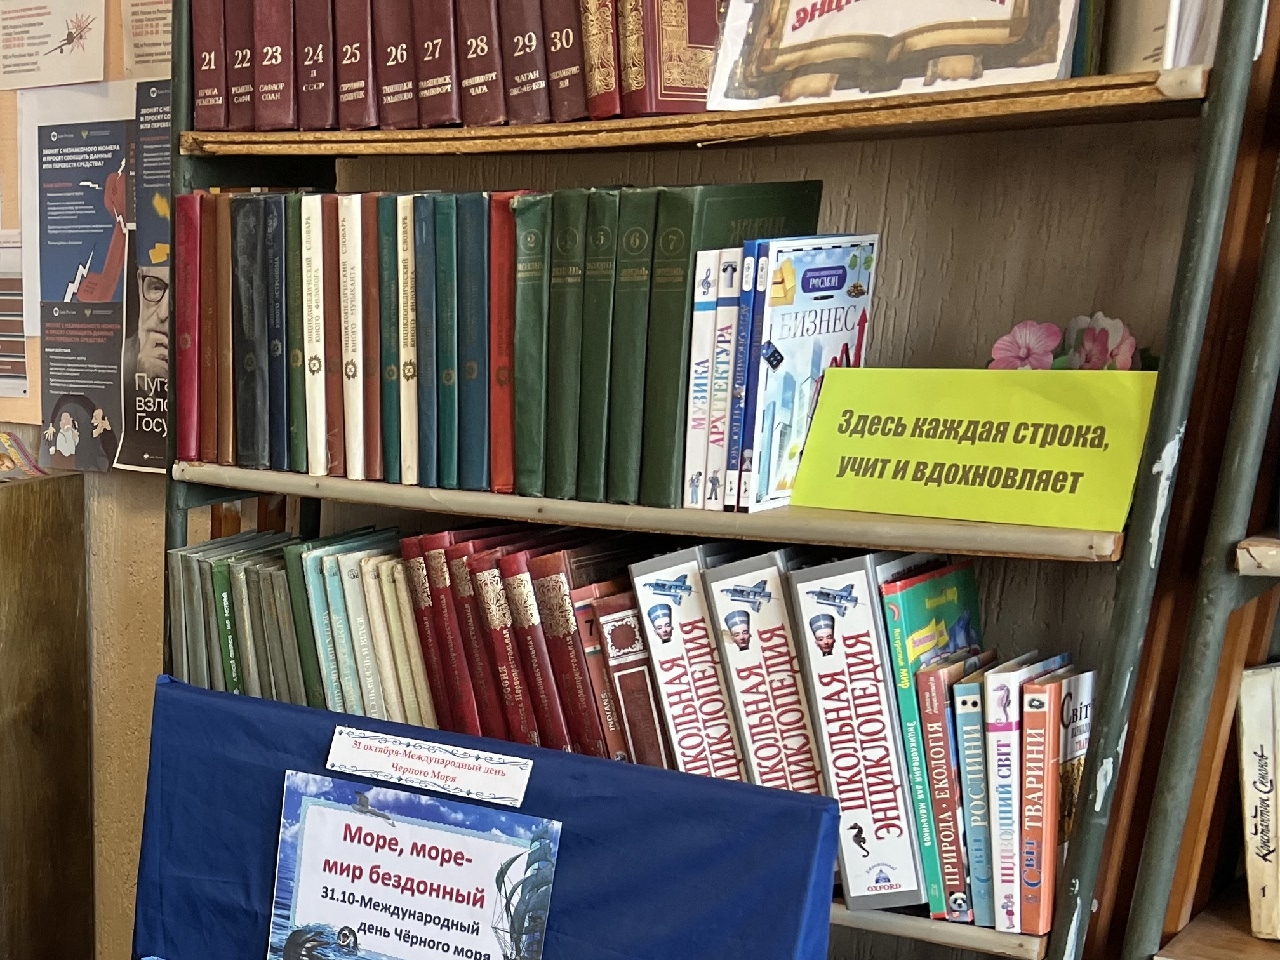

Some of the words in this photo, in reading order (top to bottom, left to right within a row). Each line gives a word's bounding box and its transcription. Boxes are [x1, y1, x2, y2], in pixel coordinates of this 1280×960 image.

[201, 51, 216, 70] 21
[234, 49, 251, 69] 22
[262, 45, 282, 66] 23
[304, 43, 324, 66] 24
[342, 43, 361, 65] 25
[386, 43, 407, 66] 26
[423, 38, 442, 61] 27
[467, 36, 489, 59] 28
[513, 32, 537, 57] 29
[551, 28, 574, 52] 30
[306, 257, 314, 343] ЭНЦИКЛОПЕДИЧЕСКИЙ
[341, 260, 350, 353] ЭНЦИКЛОПЕДИЧЕСКИЙ
[349, 266, 357, 315] МУЗЫКАНТА
[402, 258, 410, 348] ЭНЦИКЛОПЕДИЧЕСКИЙ
[313, 315, 321, 343] ЮНОГО
[349, 323, 357, 353] ЮНОГО
[779, 305, 858, 339] БИЗНЕС
[690, 359, 711, 430] МУЗИКА
[709, 324, 734, 447] АРХІТЕКТУРА
[837, 409, 907, 438] Здесь
[909, 416, 1010, 446] каждая
[1012, 420, 1110, 453] строка,
[836, 454, 889, 479] учит
[892, 459, 907, 478] и
[911, 460, 1084, 495] вдохновляет
[679, 617, 742, 782] ЦИКЛОПЕДИЯ
[757, 623, 822, 796] ЦИКЛОПЕДИЯ
[1061, 692, 1091, 728] Світ
[817, 669, 865, 815] ШКОЛЬНАЯ
[842, 630, 903, 840] ЭНЦИКЛОПЕДИЯ
[351, 740, 362, 751] 31
[363, 743, 481, 774] октября-Международный
[481, 765, 507, 778] день
[391, 762, 429, 777] Черного
[430, 769, 457, 784] Моря
[926, 721, 951, 799] ЕКОЛОГІЯ
[967, 724, 991, 828] РОСЛИНИ
[996, 740, 1014, 779] СВІТ
[1024, 727, 1045, 830] ТВАРИНИ
[343, 823, 404, 857] Море,
[410, 842, 473, 867] море-
[942, 808, 963, 886] ПРИРОДА
[1022, 839, 1041, 888] Світ
[323, 857, 364, 883] мир
[370, 864, 486, 910] бездонный
[866, 881, 902, 893] OXFORD
[320, 886, 480, 937] 31.10-Международный
[356, 920, 391, 940] день
[394, 925, 450, 954] Чёрного
